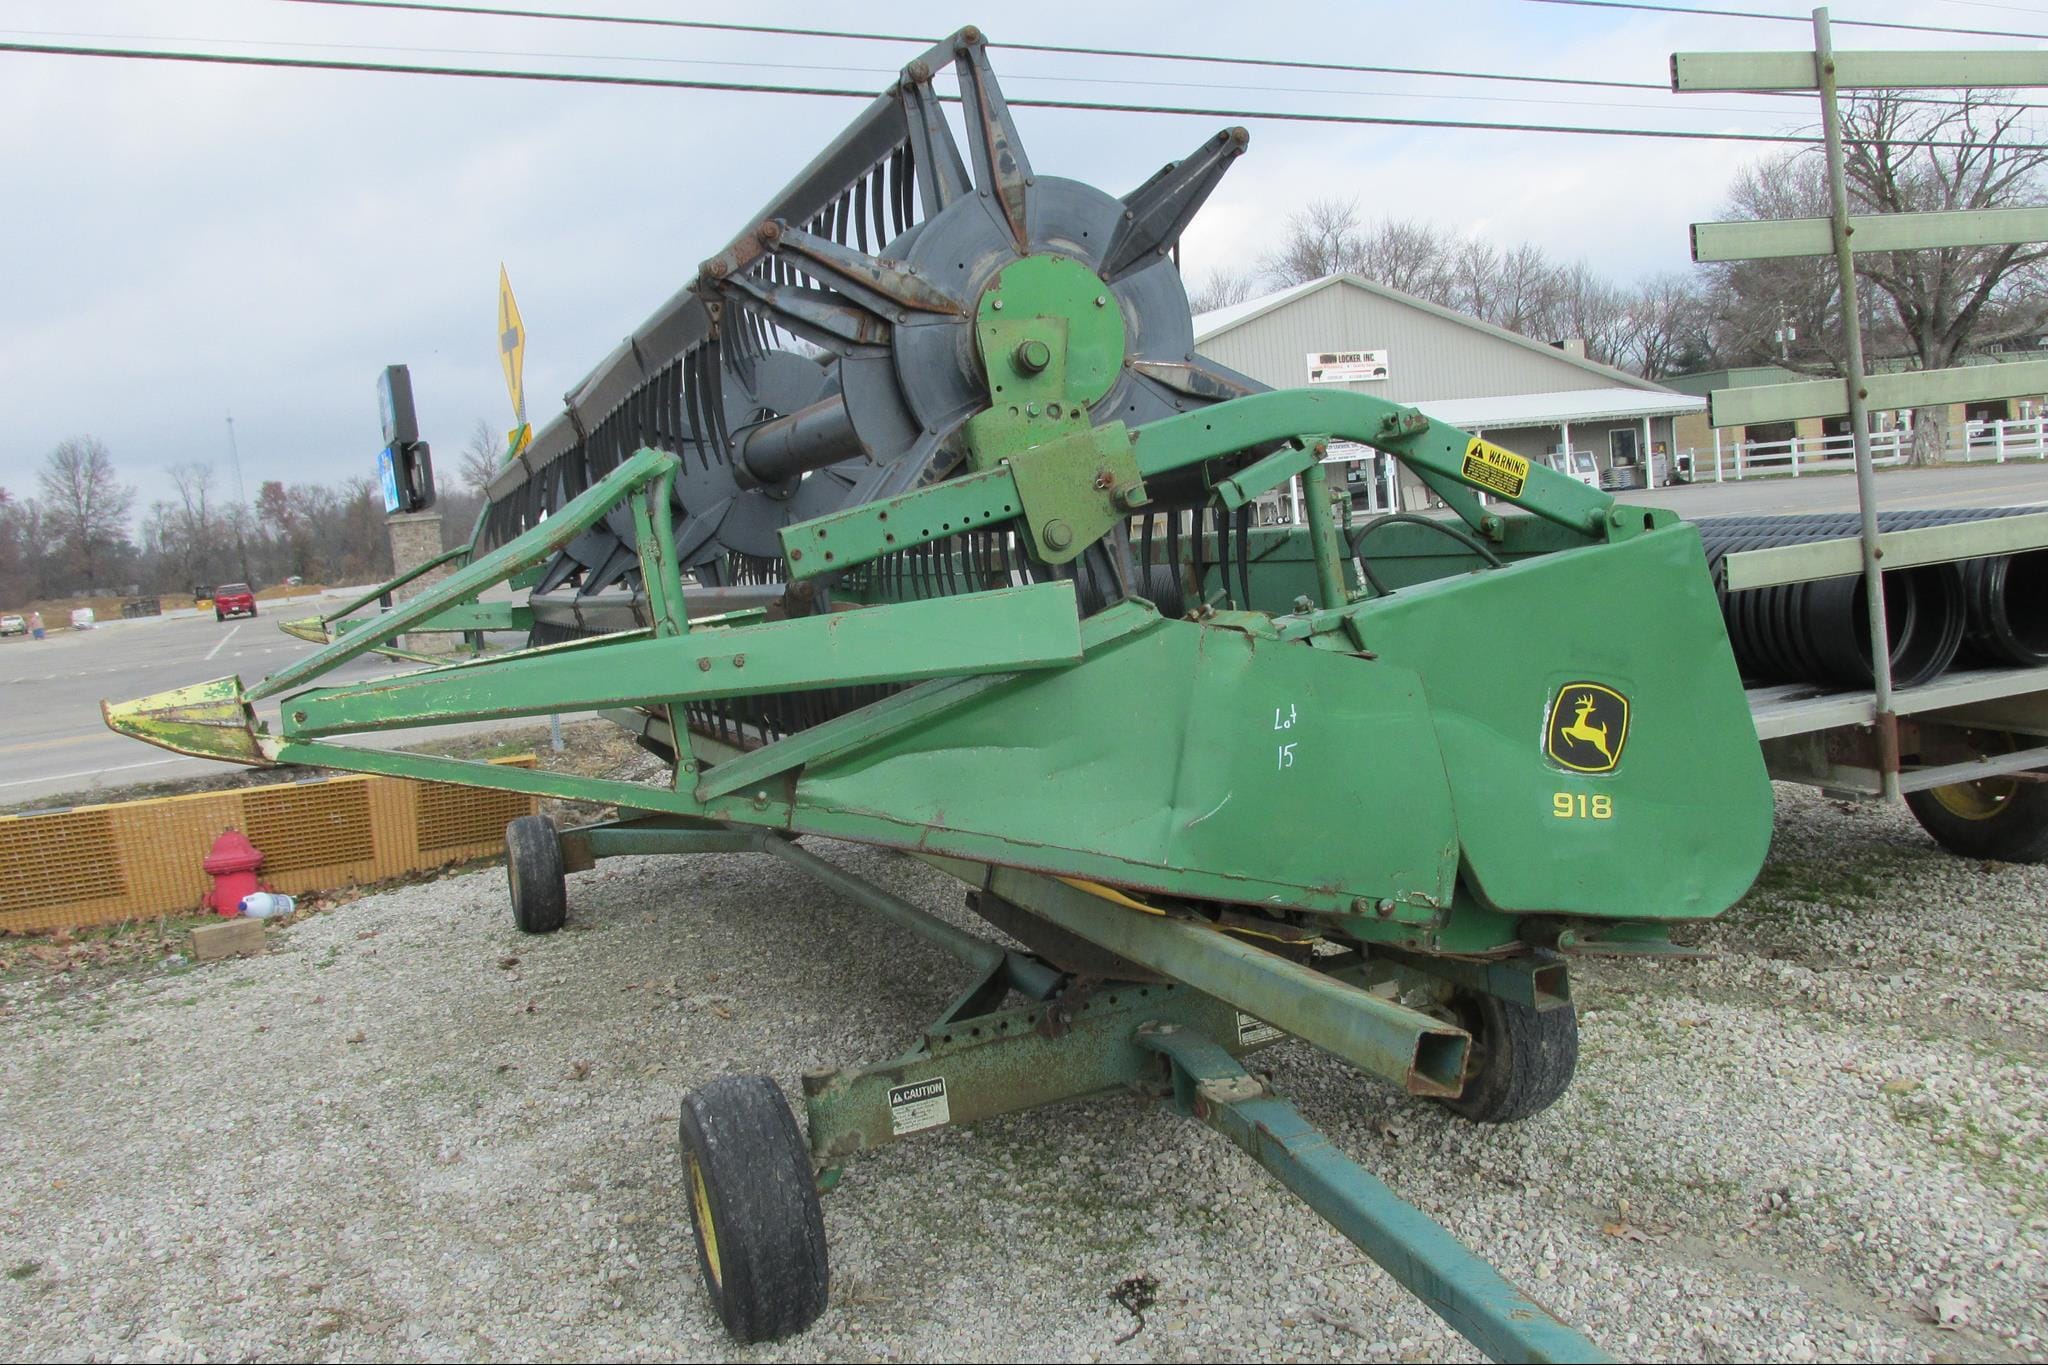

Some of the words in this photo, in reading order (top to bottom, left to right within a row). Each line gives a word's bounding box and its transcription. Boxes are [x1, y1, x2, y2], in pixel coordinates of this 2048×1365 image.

[1488, 450, 1526, 476] WARNING
[1274, 703, 1297, 730] Lot
[1278, 742, 1298, 770] 15
[1553, 792, 1612, 819] 918
[903, 1082, 942, 1101] CAUTION
